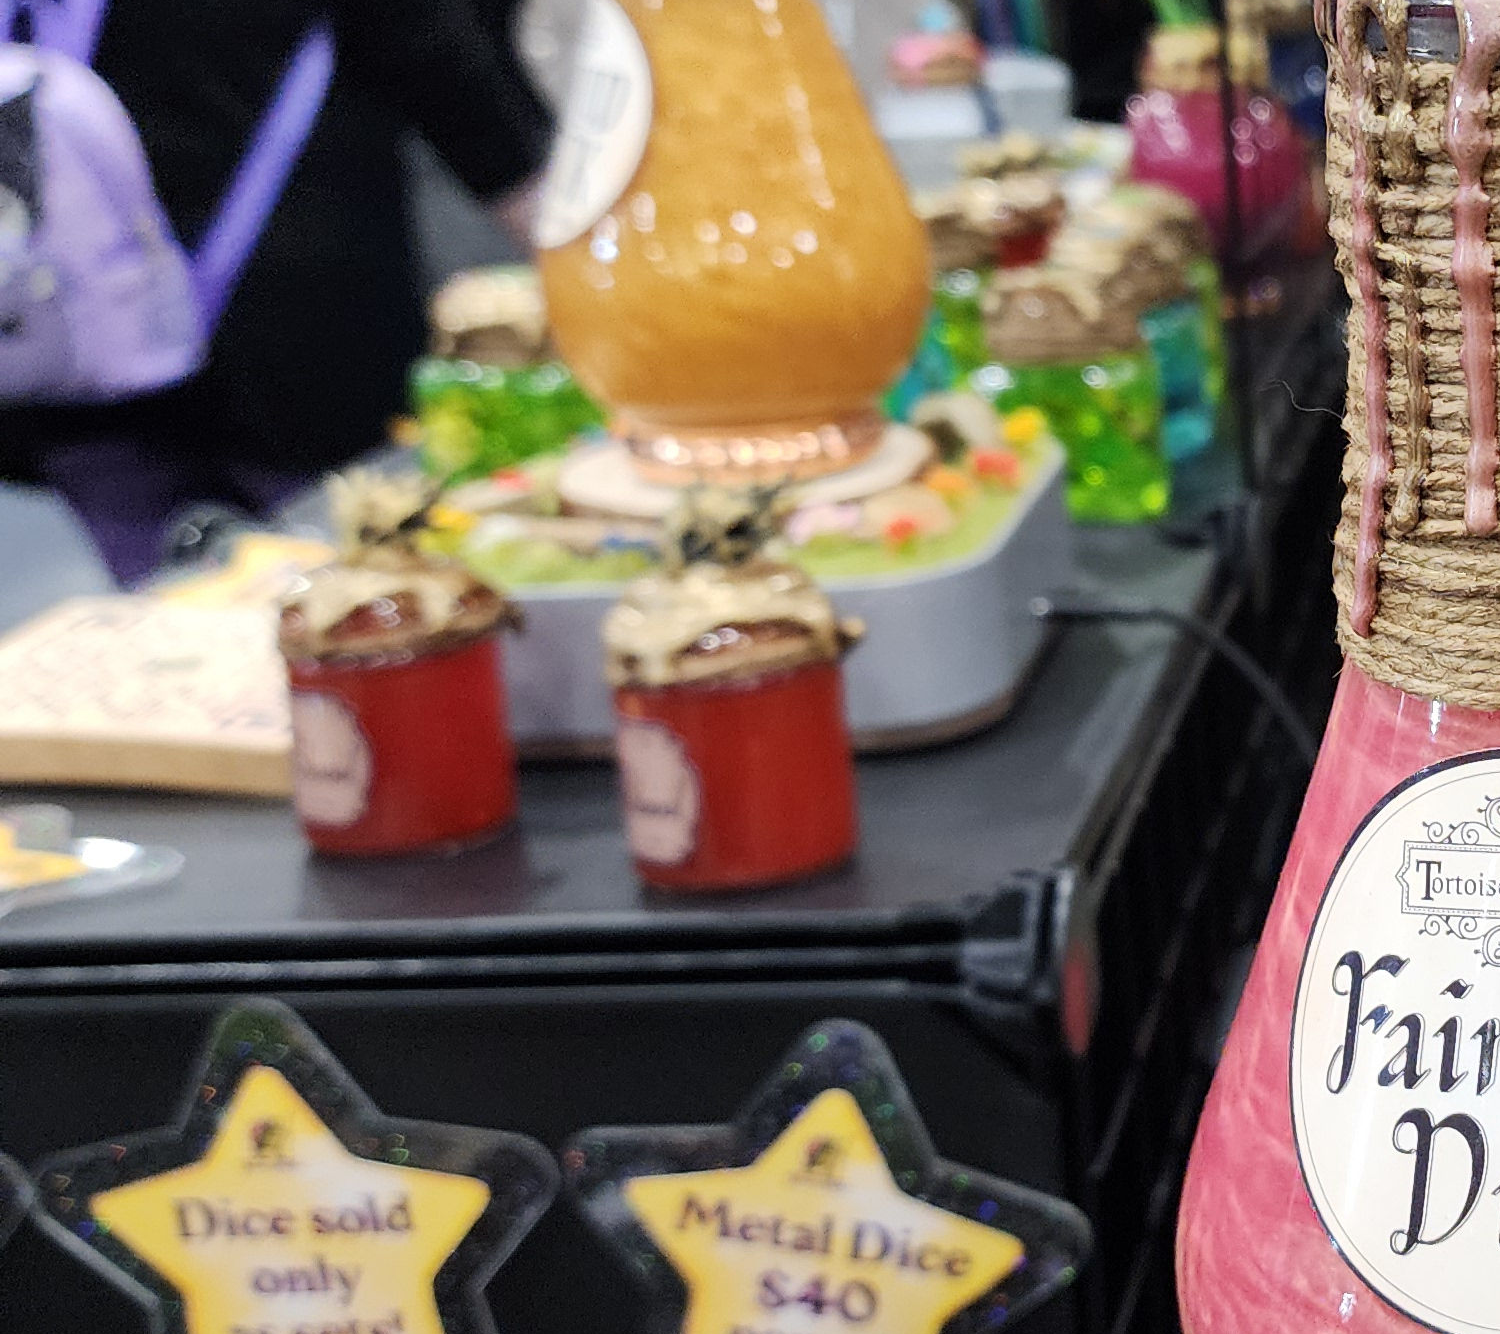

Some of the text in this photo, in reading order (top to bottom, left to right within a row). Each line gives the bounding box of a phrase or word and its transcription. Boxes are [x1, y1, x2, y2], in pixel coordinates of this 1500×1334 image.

[174, 1191, 414, 1239] Dice sold
[676, 1193, 972, 1278] Metal Dice
[252, 1255, 362, 1307] only
